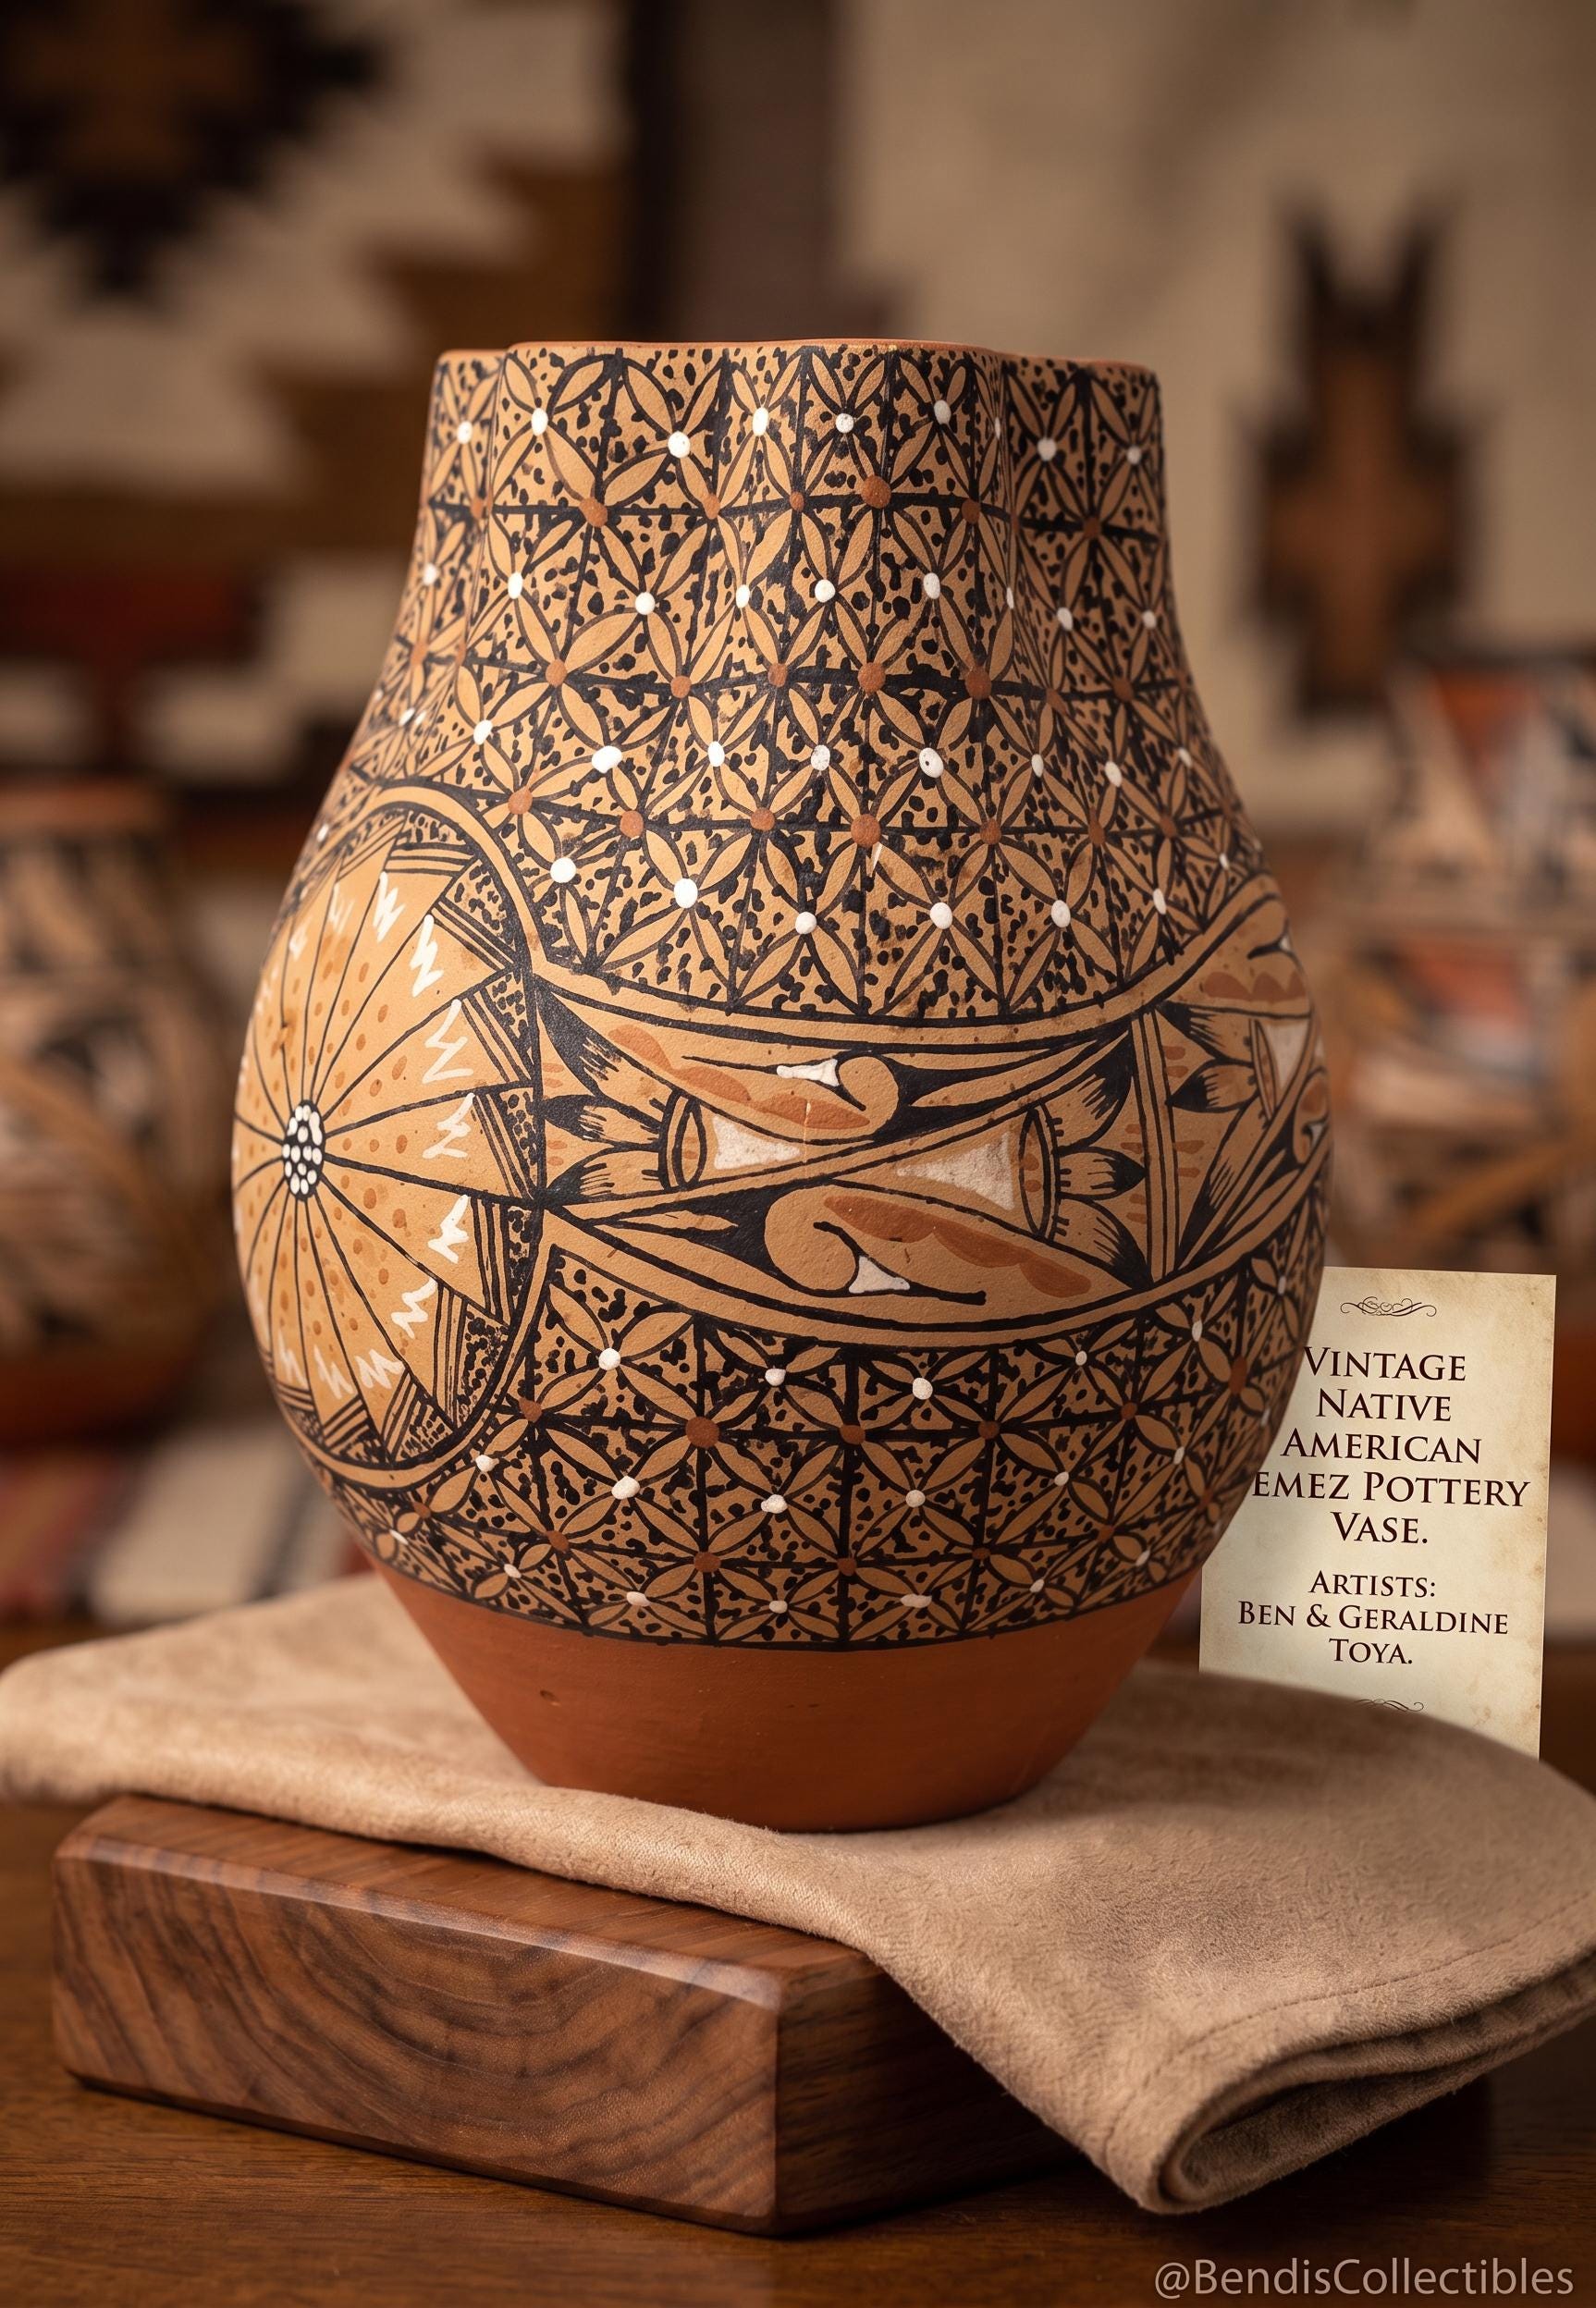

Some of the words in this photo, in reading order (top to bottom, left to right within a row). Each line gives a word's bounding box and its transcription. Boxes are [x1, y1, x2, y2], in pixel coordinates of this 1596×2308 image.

[1303, 1346, 1466, 1381] VINTAGE
[1317, 1388, 1452, 1422] NATIVE
[1280, 1428, 1481, 1464] AMERICAN
[1252, 1471, 1350, 1500] EMEZ
[1363, 1471, 1531, 1507] POTTERY
[1331, 1511, 1428, 1544] VASE.
[1308, 1570, 1436, 1598] ARTISTS:
[1237, 1601, 1296, 1627] BEN
[1306, 1604, 1332, 1628] &
[1338, 1605, 1508, 1635] GERALDINE
[1329, 1638, 1413, 1664] TOYA.
